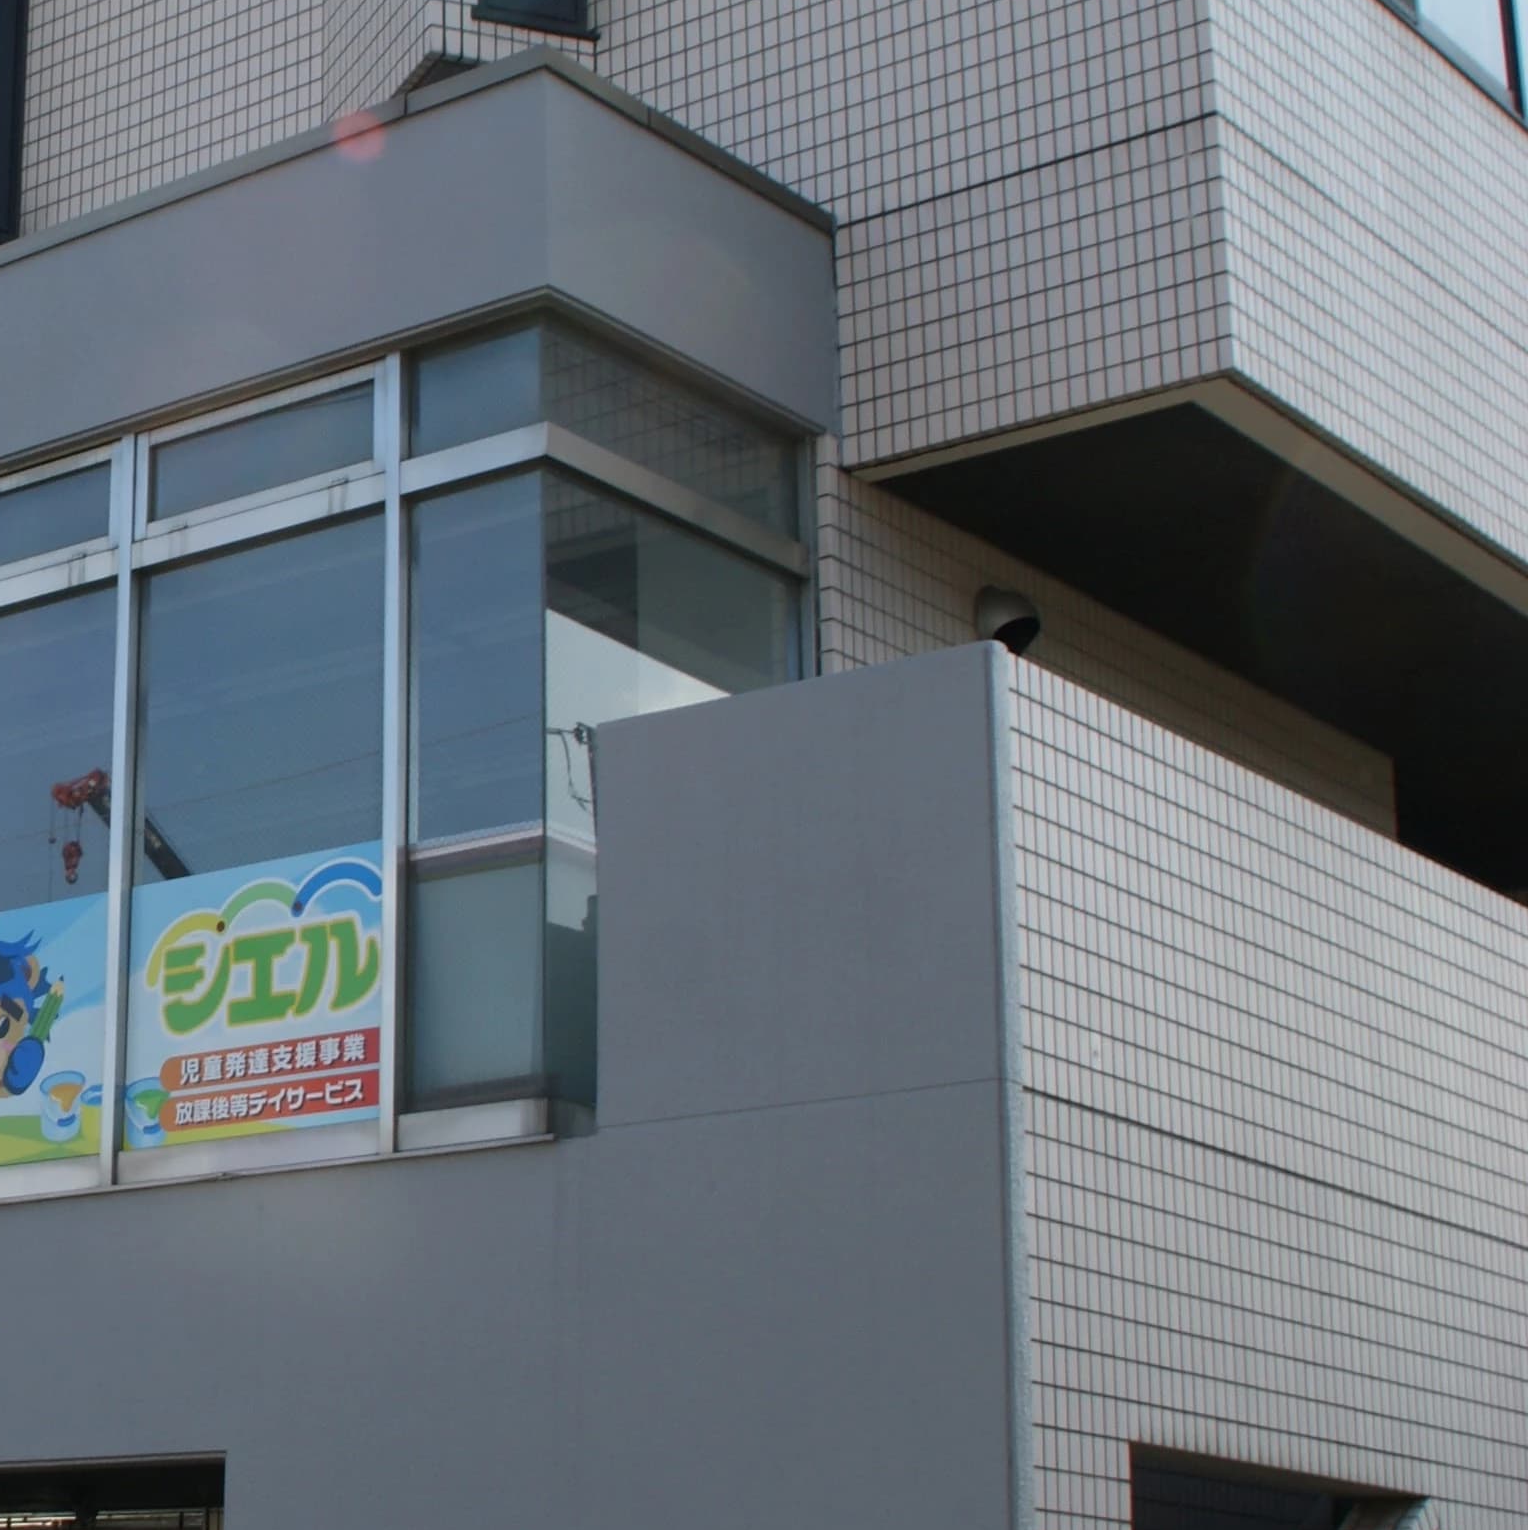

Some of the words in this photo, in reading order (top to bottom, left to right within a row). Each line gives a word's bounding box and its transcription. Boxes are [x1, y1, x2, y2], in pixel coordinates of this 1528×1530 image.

[179, 1034, 366, 1086] 児童発達支援事業
[174, 1078, 363, 1126] 放課後等デイサービス
